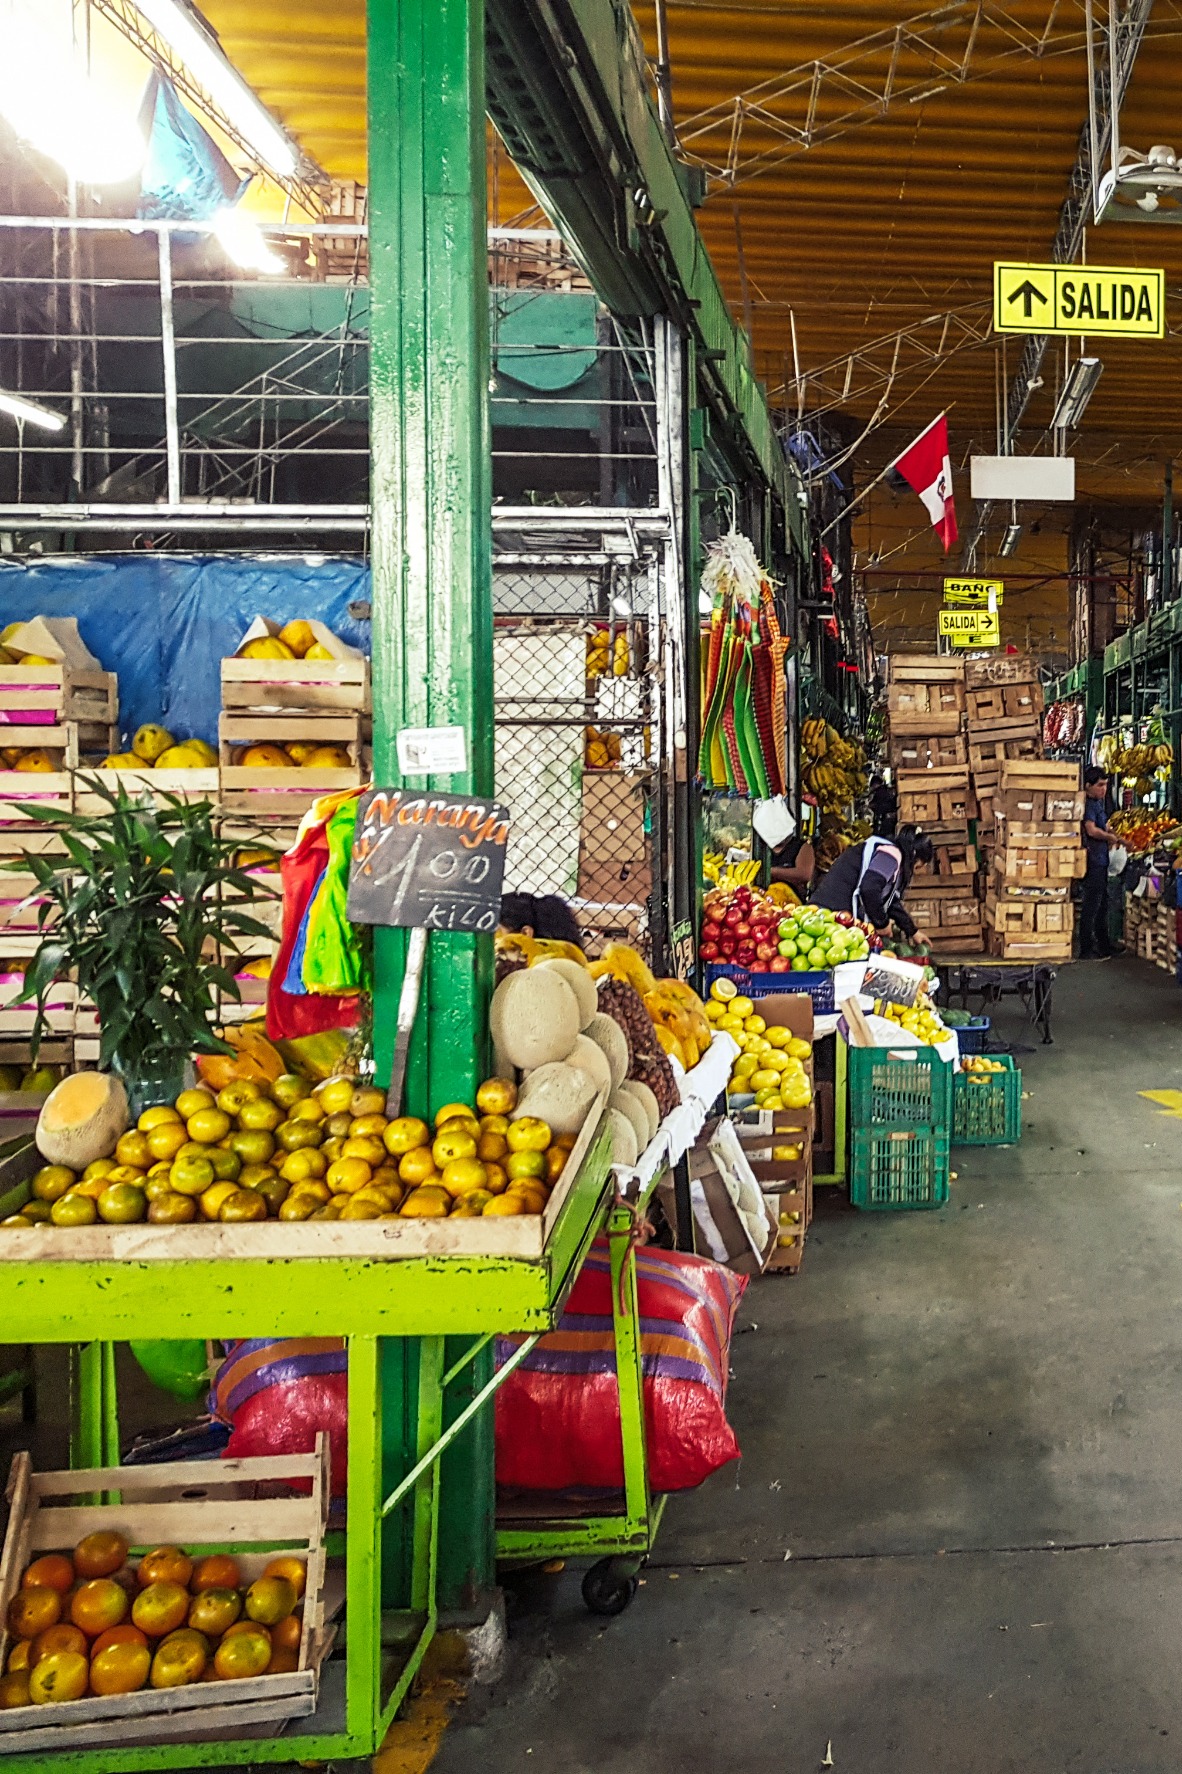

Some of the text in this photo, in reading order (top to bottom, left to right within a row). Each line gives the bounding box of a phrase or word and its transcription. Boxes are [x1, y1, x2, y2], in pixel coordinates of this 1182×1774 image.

[1061, 281, 1153, 321] SALIDA
[943, 616, 975, 629] SALIDA
[364, 791, 511, 848] Naranja
